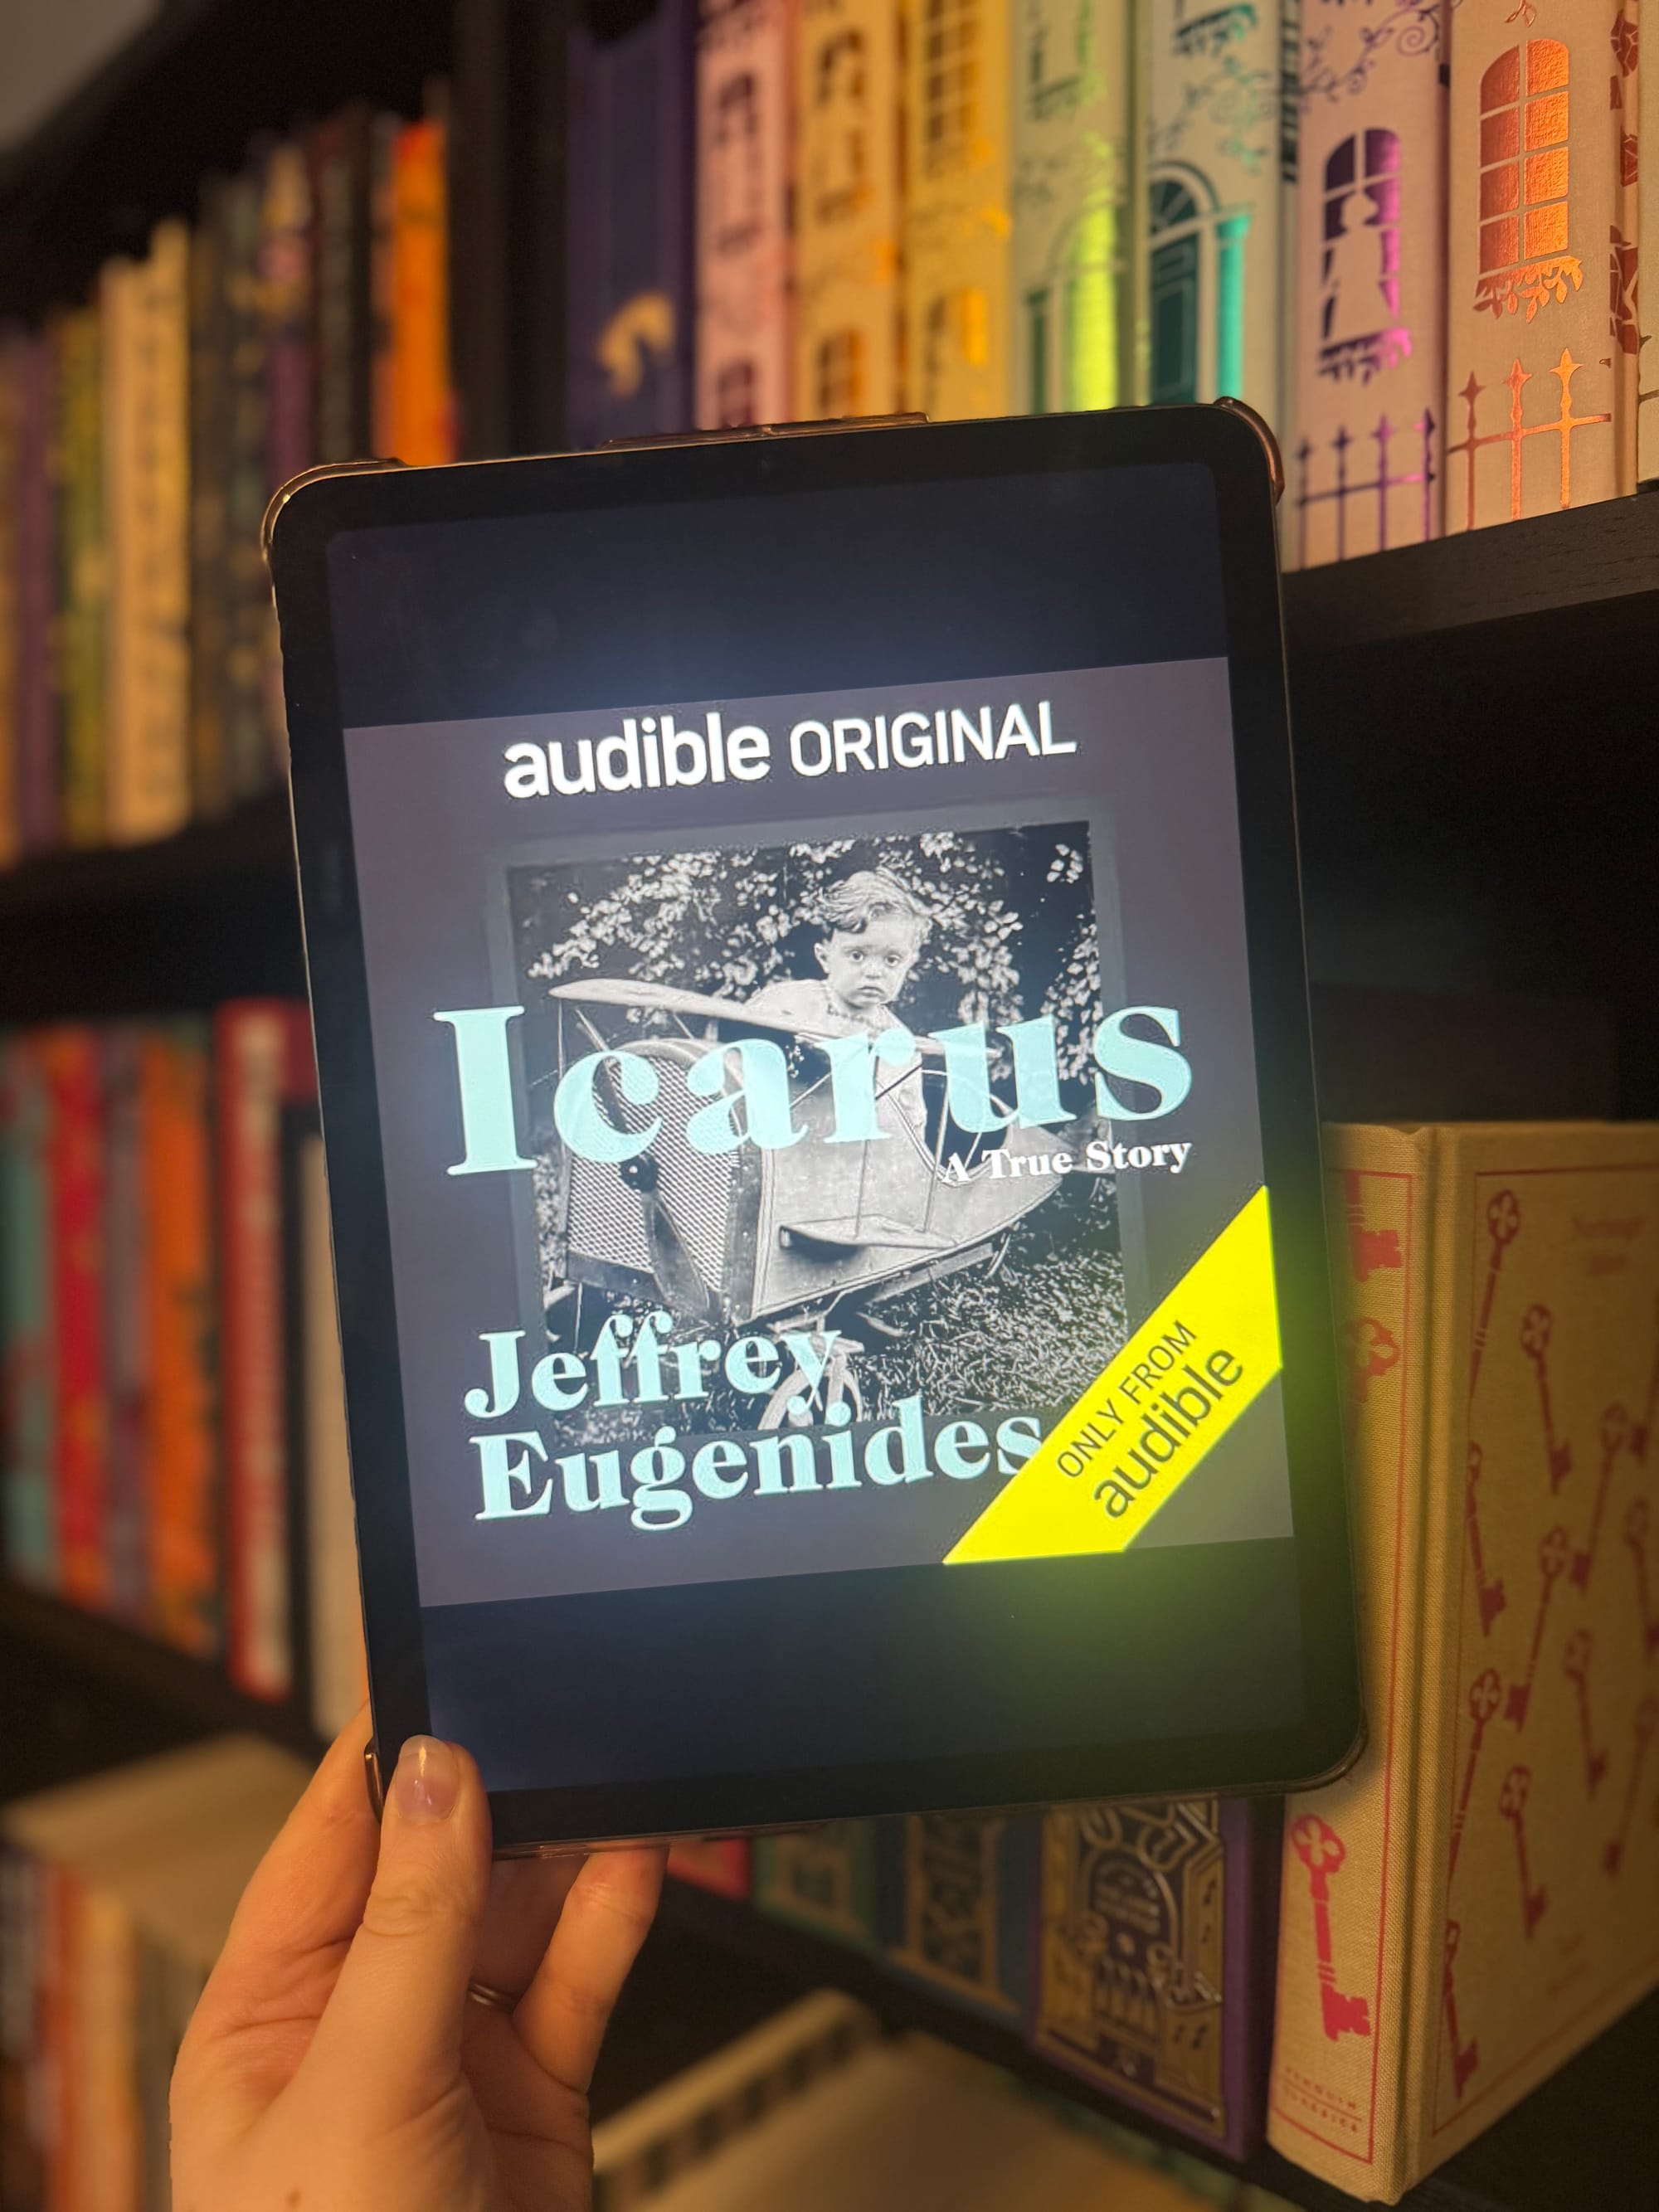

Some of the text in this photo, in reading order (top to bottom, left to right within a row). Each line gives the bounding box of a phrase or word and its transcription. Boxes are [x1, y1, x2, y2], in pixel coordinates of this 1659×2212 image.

[504, 700, 1078, 799] audible ORIGINAL
[432, 1005, 1194, 1176] Icarus
[941, 1140, 1193, 1184] A True Story
[464, 1310, 842, 1419] Jeffrey
[1057, 1320, 1197, 1478] ONLY FROM
[469, 1394, 1042, 1530] Eugenides
[1093, 1349, 1243, 1518] audible
